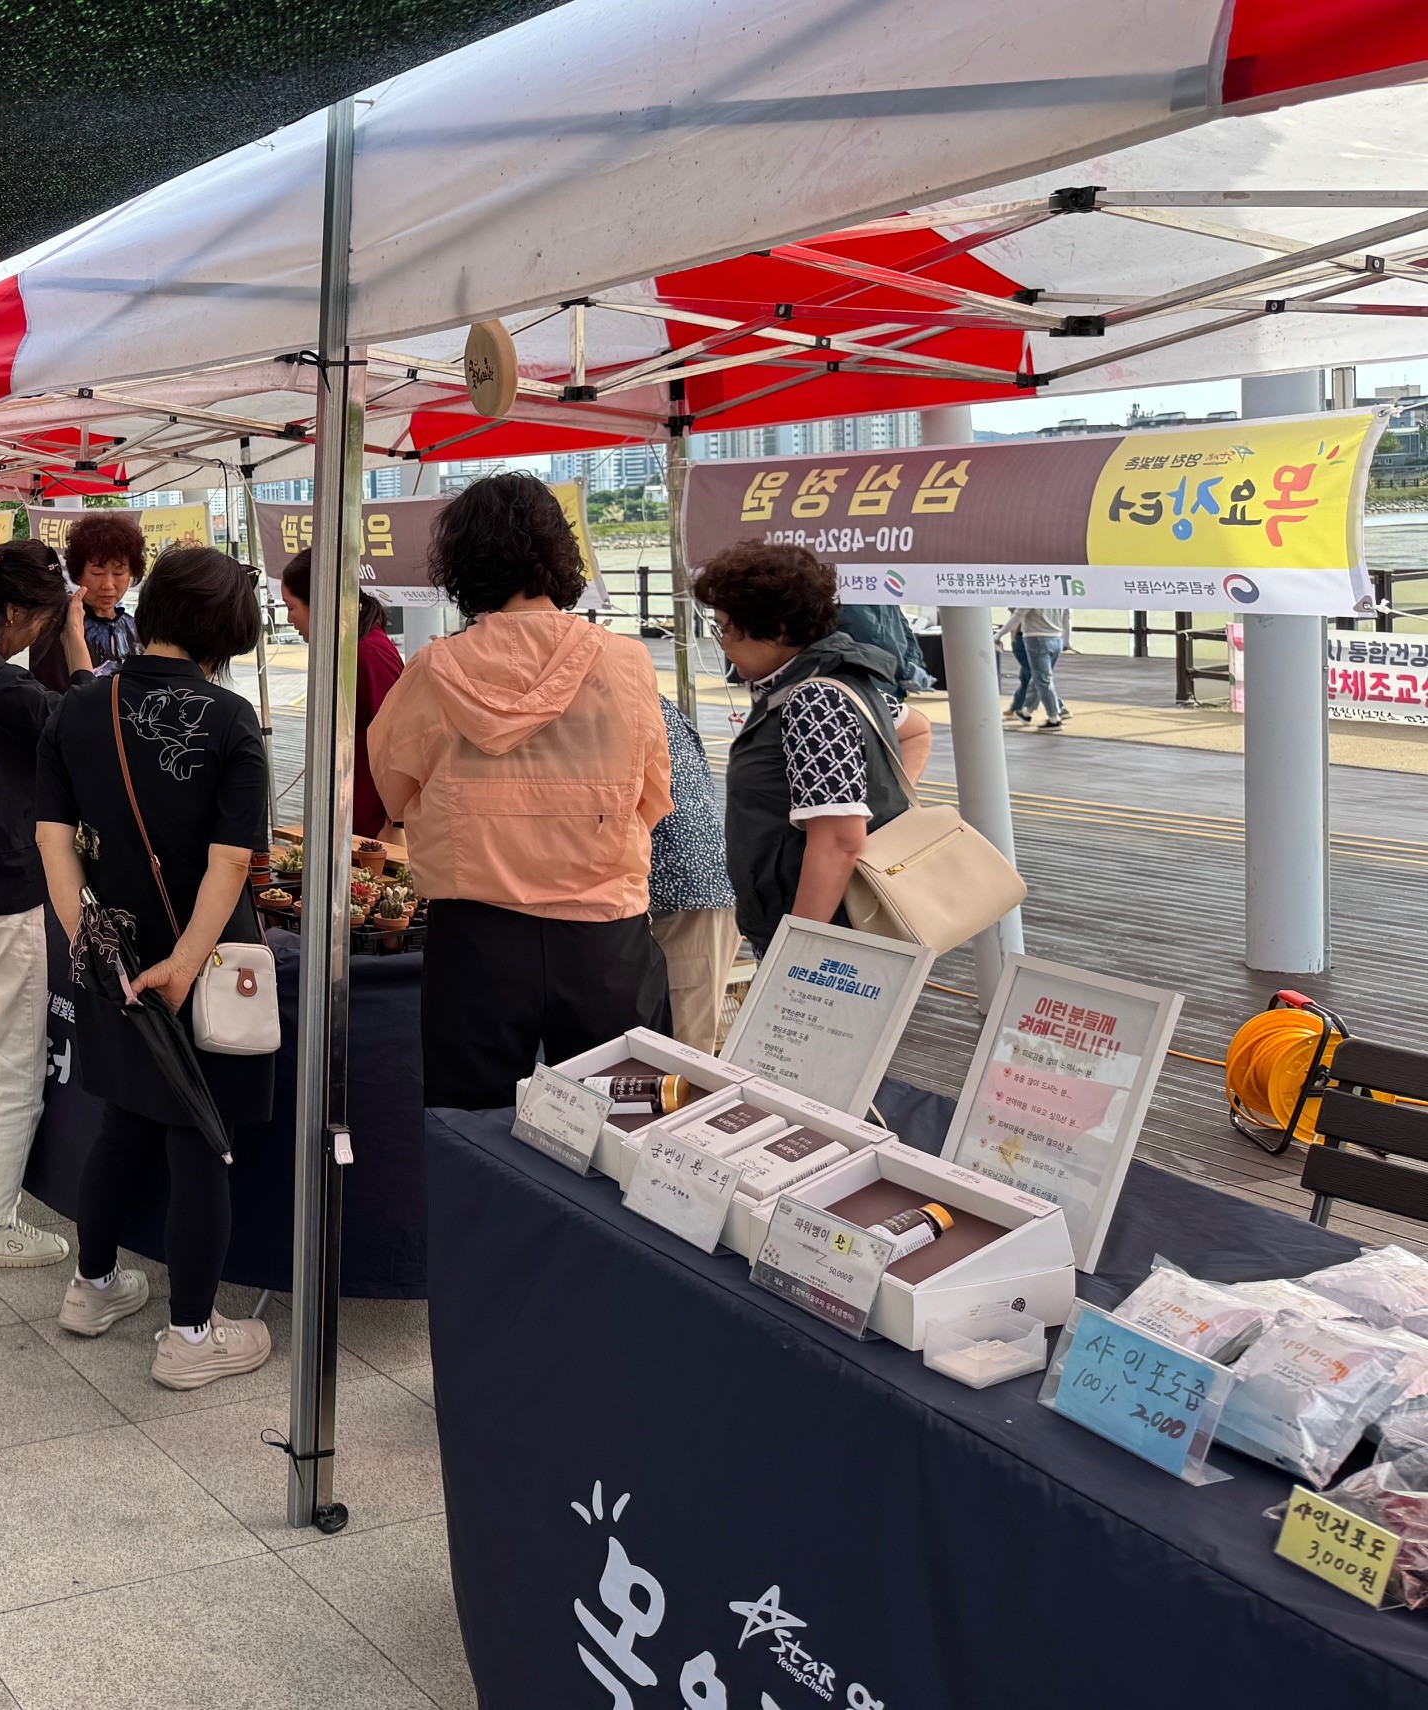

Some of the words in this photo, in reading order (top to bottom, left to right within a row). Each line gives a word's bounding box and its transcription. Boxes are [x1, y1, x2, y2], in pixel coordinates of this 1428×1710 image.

[787, 965, 809, 981] 이런
[806, 969, 836, 989] 효능이
[835, 978, 881, 1000] 있습니다!
[1034, 996, 1067, 1020] 이런
[1066, 1005, 1118, 1036] 분들께
[1017, 1014, 1121, 1061] 권해드립니다!
[1022, 1049, 1044, 1063] 피로감을
[1041, 1080, 1059, 1095] 드시는
[997, 1119, 1025, 1136] 피부미용에
[1027, 1129, 1045, 1143] 관심이
[1032, 1157, 1056, 1175] 필요하신
[981, 1167, 1014, 1187] 부모님건강을
[1016, 1179, 1028, 1192] 위한
[794, 1217, 830, 1242] 파워벵이
[829, 1266, 855, 1284] 50,000원
[1128, 1402, 1187, 1440] 2,000
[1306, 1540, 1378, 1595] 3,000원
[776, 1653, 833, 1702] YeongCheon
